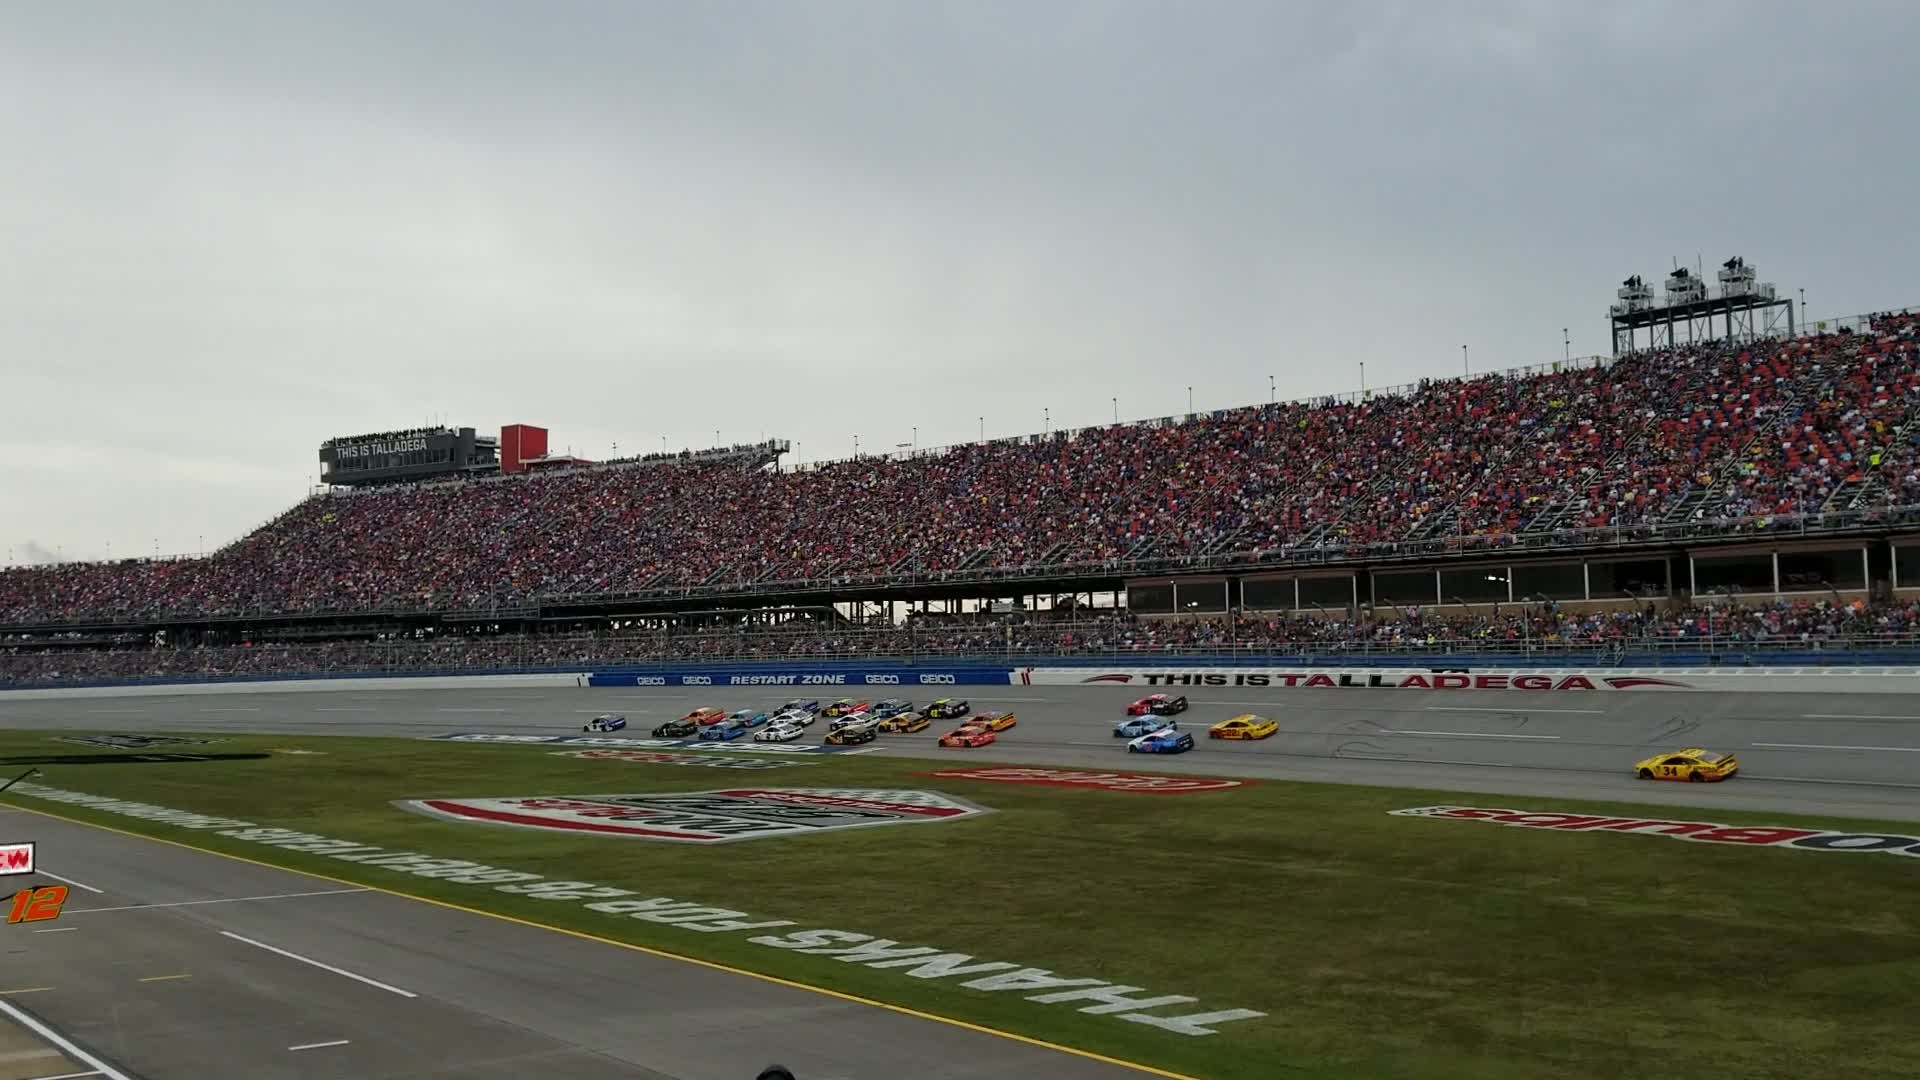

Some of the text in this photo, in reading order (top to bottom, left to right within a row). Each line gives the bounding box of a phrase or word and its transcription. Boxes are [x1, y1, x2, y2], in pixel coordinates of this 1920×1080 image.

[336, 438, 428, 459] THIS IS TALLADEGA
[637, 676, 665, 686] GEICO
[682, 675, 712, 685] GEICO
[730, 674, 846, 685] RESTART ZONE
[865, 674, 899, 684] GEICO
[919, 674, 955, 684] GEICO
[1143, 673, 1598, 690] THIS IS TALLADEGA
[1663, 766, 1678, 777] 34
[7, 886, 69, 924] 12
[214, 828, 1269, 1036] THANKS FOR 26 GREAT YEARS
